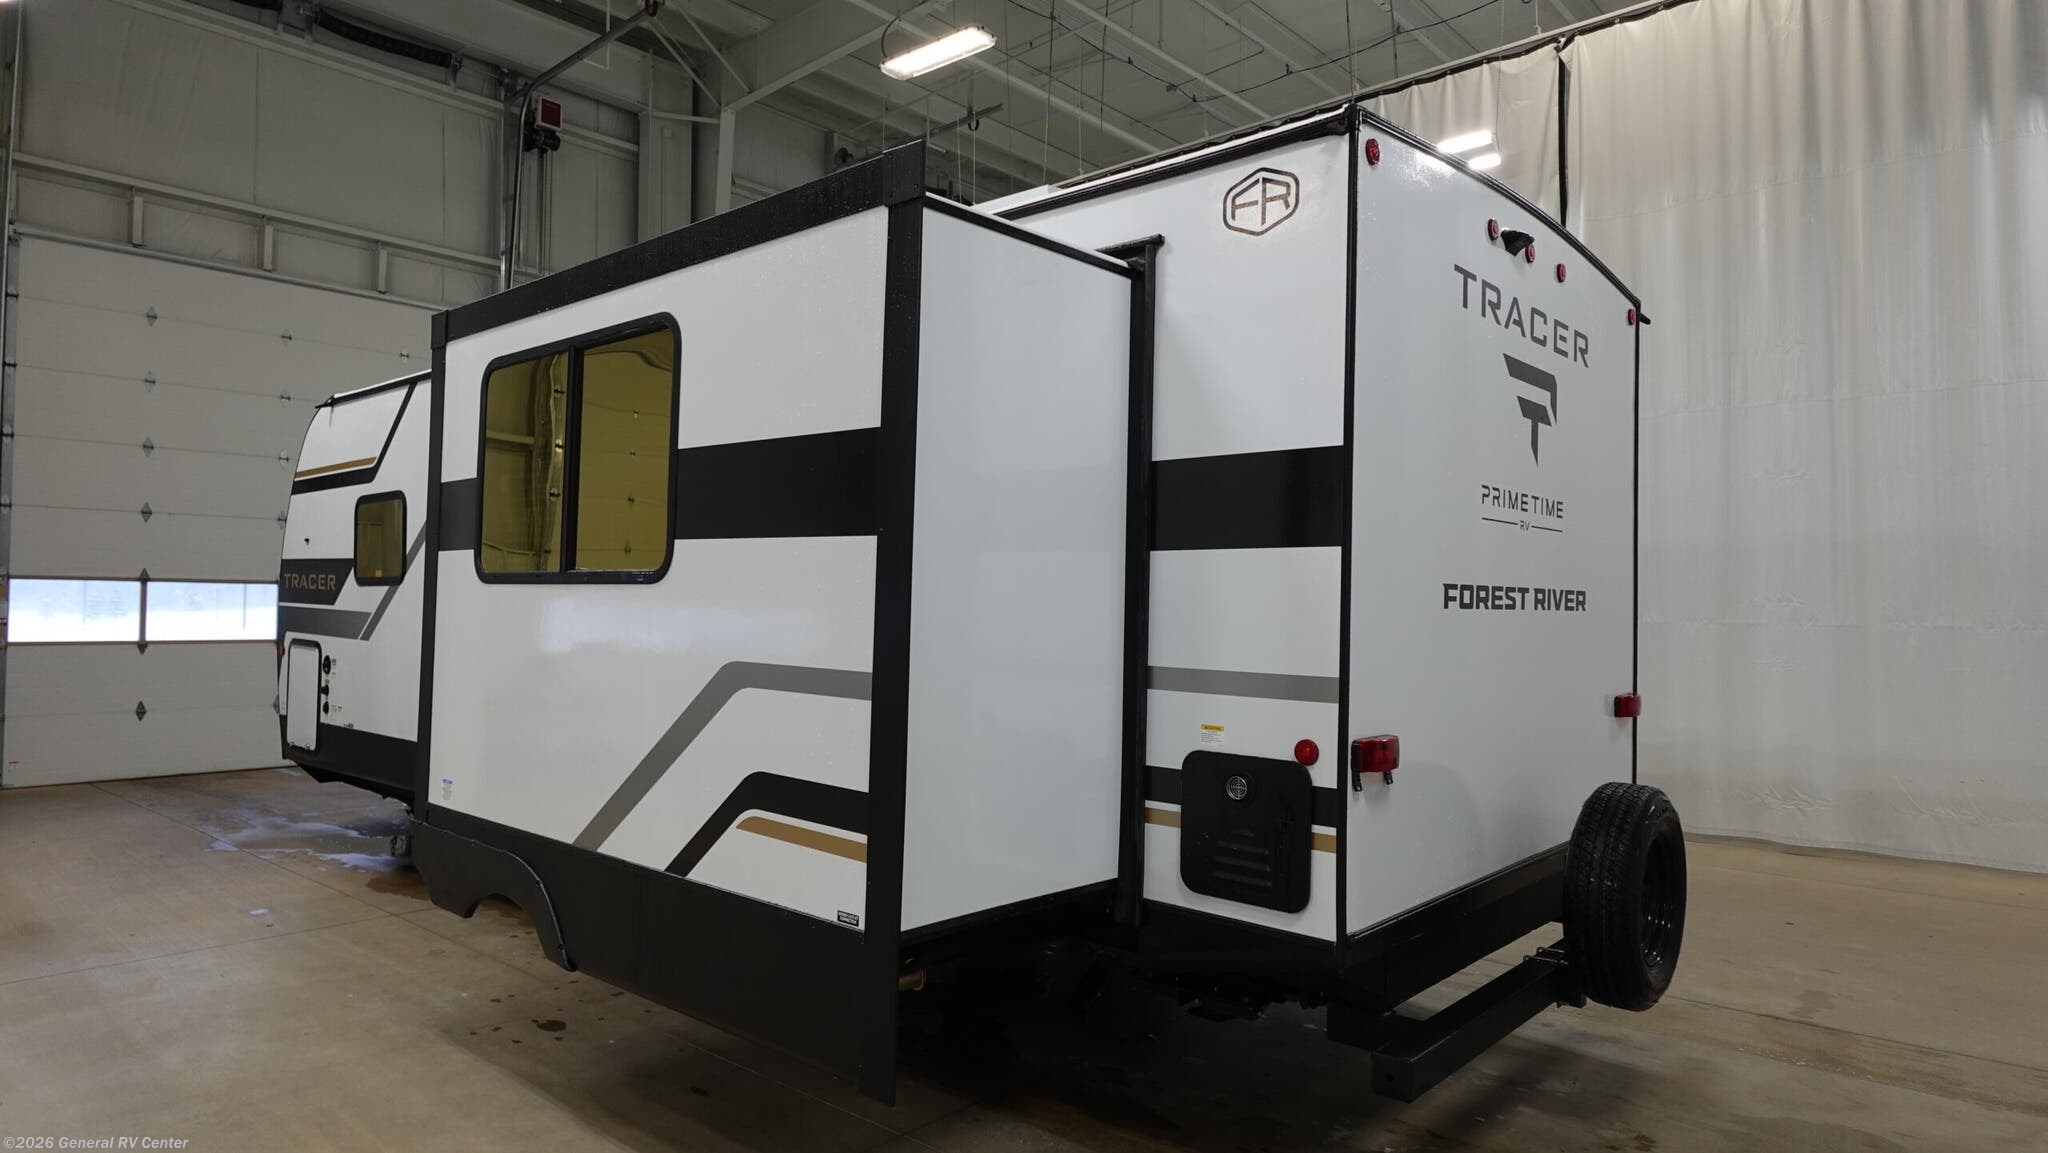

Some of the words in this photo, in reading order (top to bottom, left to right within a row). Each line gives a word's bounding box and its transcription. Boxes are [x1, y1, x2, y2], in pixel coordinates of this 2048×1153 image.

[1454, 263, 1589, 369] TRACER
[1519, 520, 1531, 531] RV
[284, 573, 336, 591] TRACER
[1443, 583, 1530, 610] FOREST
[1533, 587, 1587, 612] RIVER
